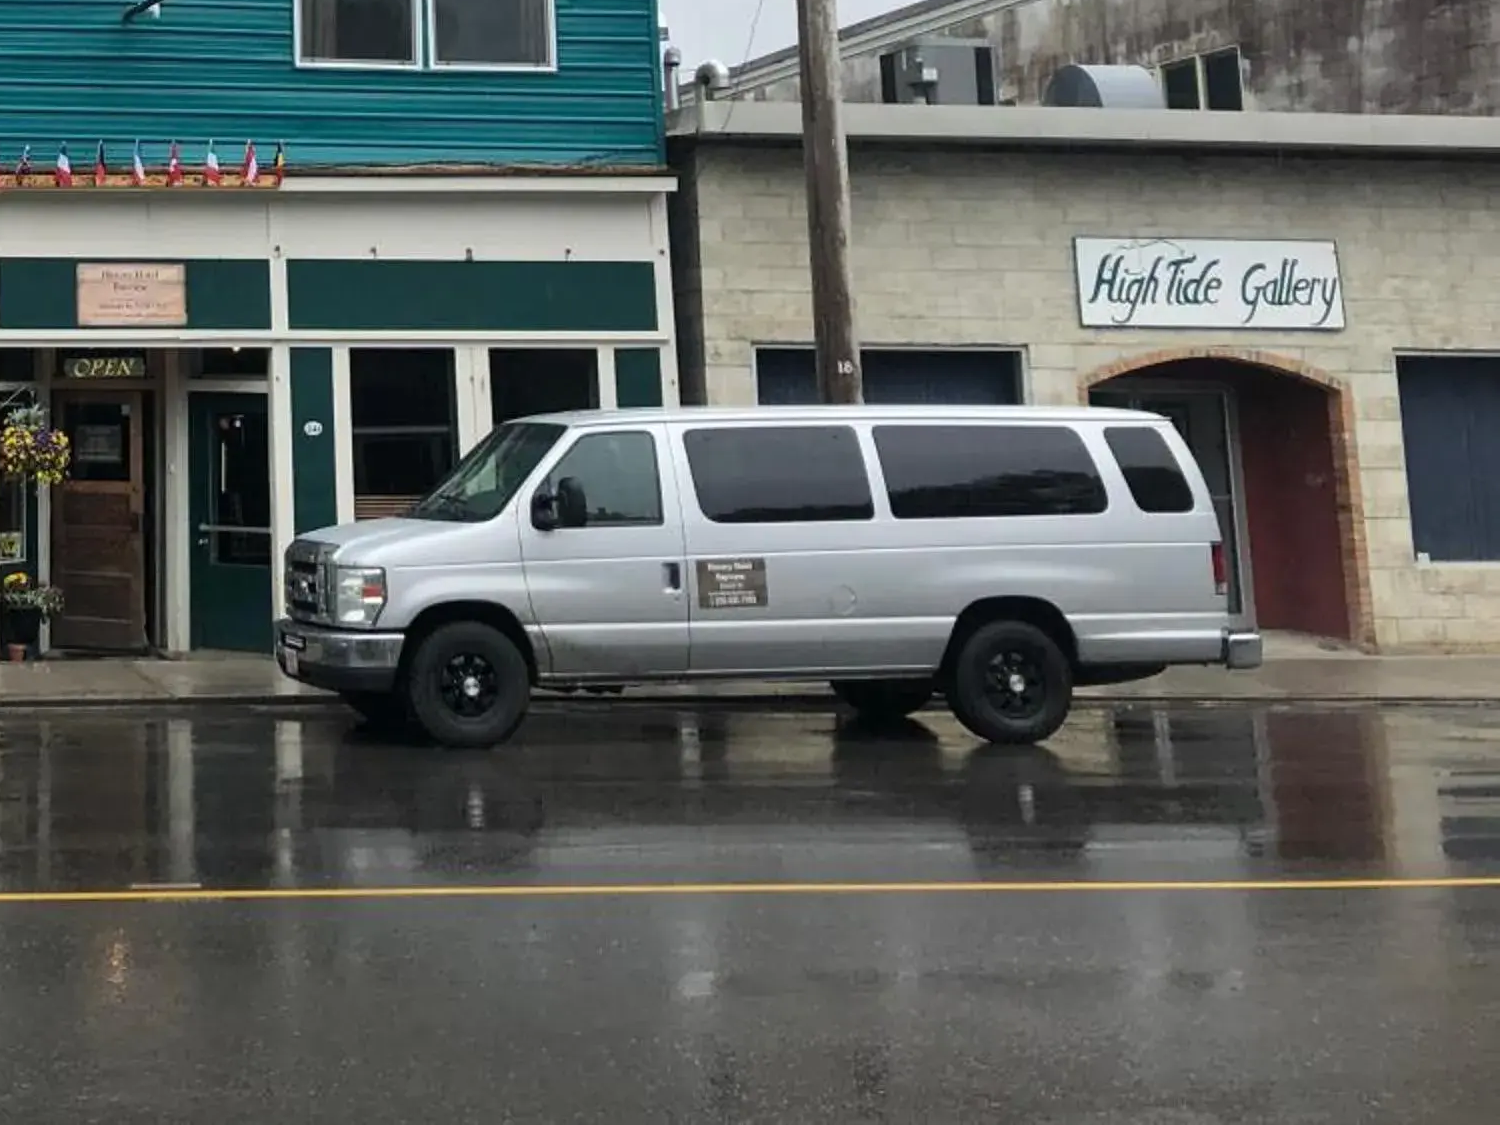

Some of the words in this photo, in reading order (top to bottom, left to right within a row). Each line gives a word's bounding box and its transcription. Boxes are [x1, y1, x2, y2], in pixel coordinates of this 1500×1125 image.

[1088, 253, 1164, 324] High
[1166, 254, 1223, 306] Tide
[1241, 258, 1336, 326] Gallery
[73, 358, 135, 377] OPEN
